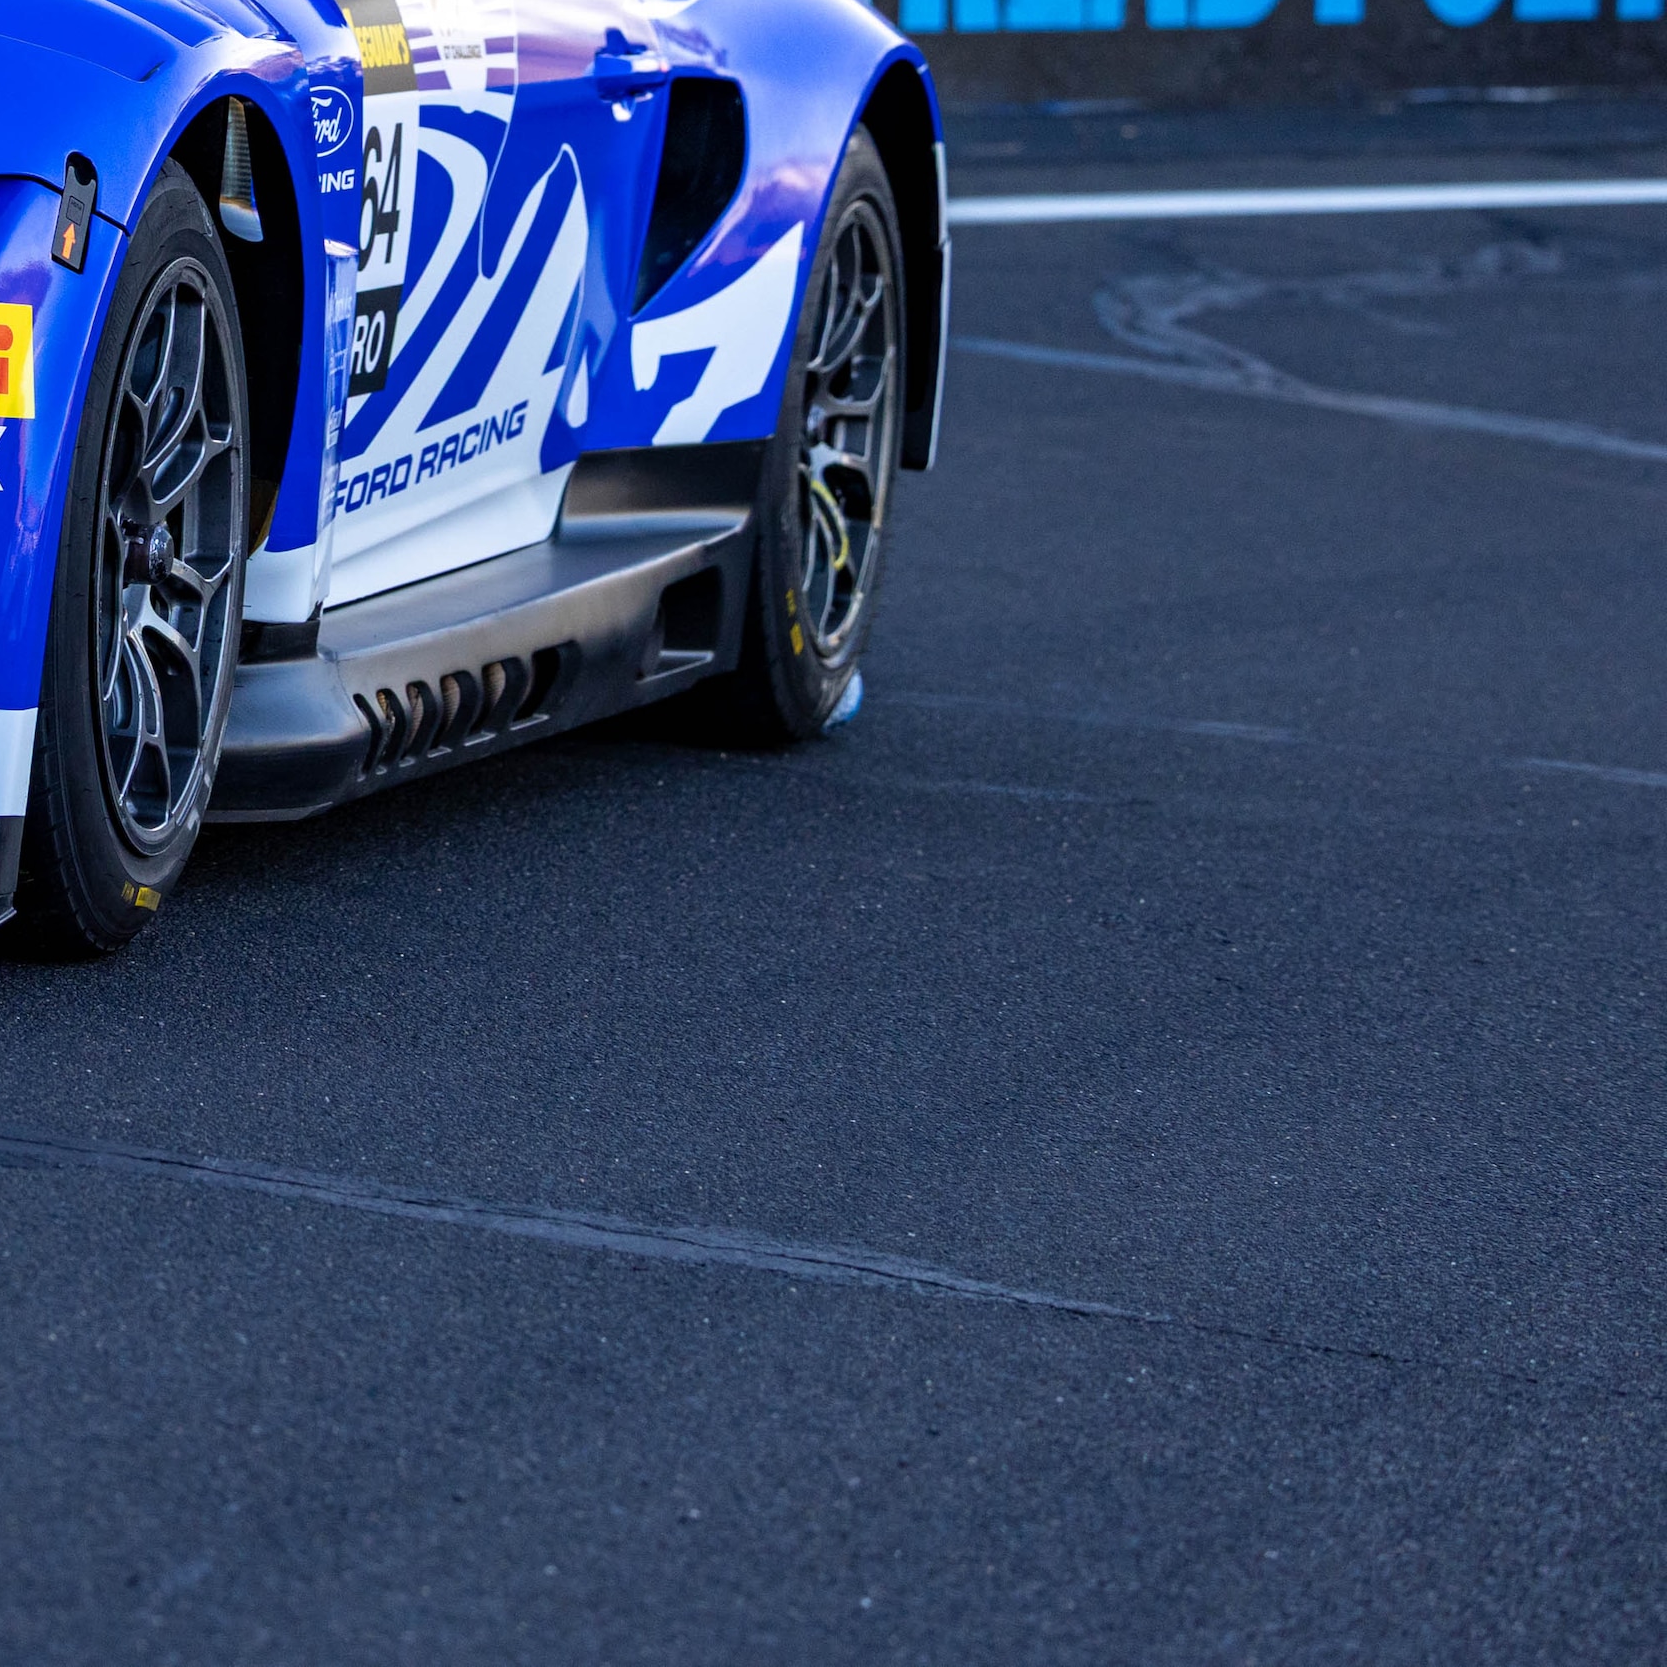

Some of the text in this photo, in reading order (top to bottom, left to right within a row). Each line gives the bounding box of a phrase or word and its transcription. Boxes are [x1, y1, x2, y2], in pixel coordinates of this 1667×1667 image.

[319, 168, 355, 194] ING
[358, 122, 403, 271] 64
[350, 310, 386, 375] RO
[333, 454, 412, 519] FORD
[416, 399, 529, 484] RACING
